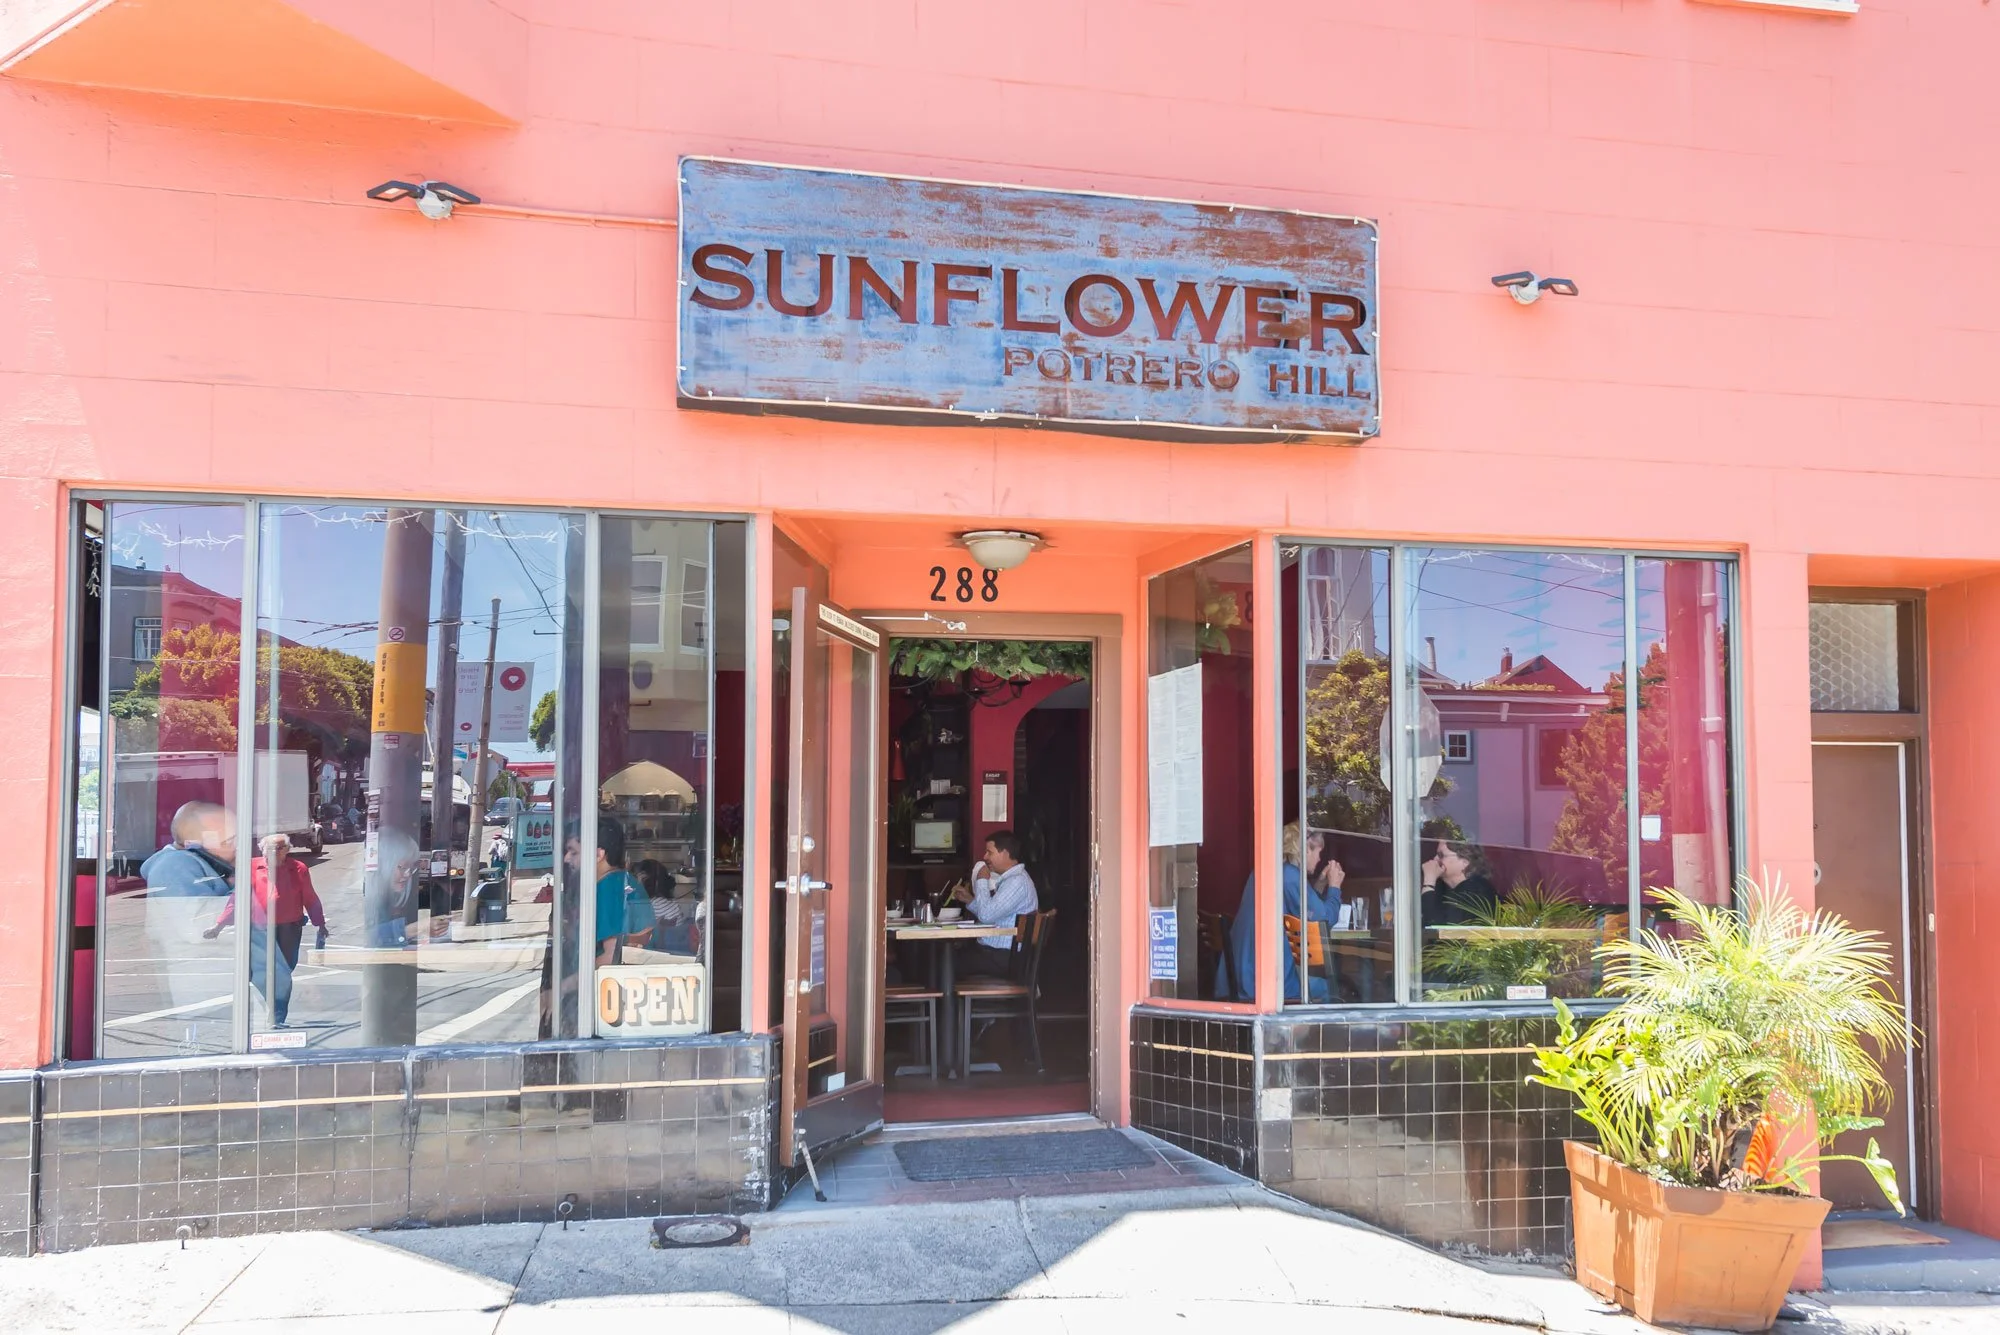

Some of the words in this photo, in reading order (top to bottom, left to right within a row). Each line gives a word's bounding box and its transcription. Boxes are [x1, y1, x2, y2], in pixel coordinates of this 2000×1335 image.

[690, 243, 1371, 356] SUNFLOWER
[1003, 347, 1240, 391] POTRERO
[1268, 363, 1371, 399] HILL
[929, 566, 999, 603] 288
[600, 976, 701, 1027] OPEN
